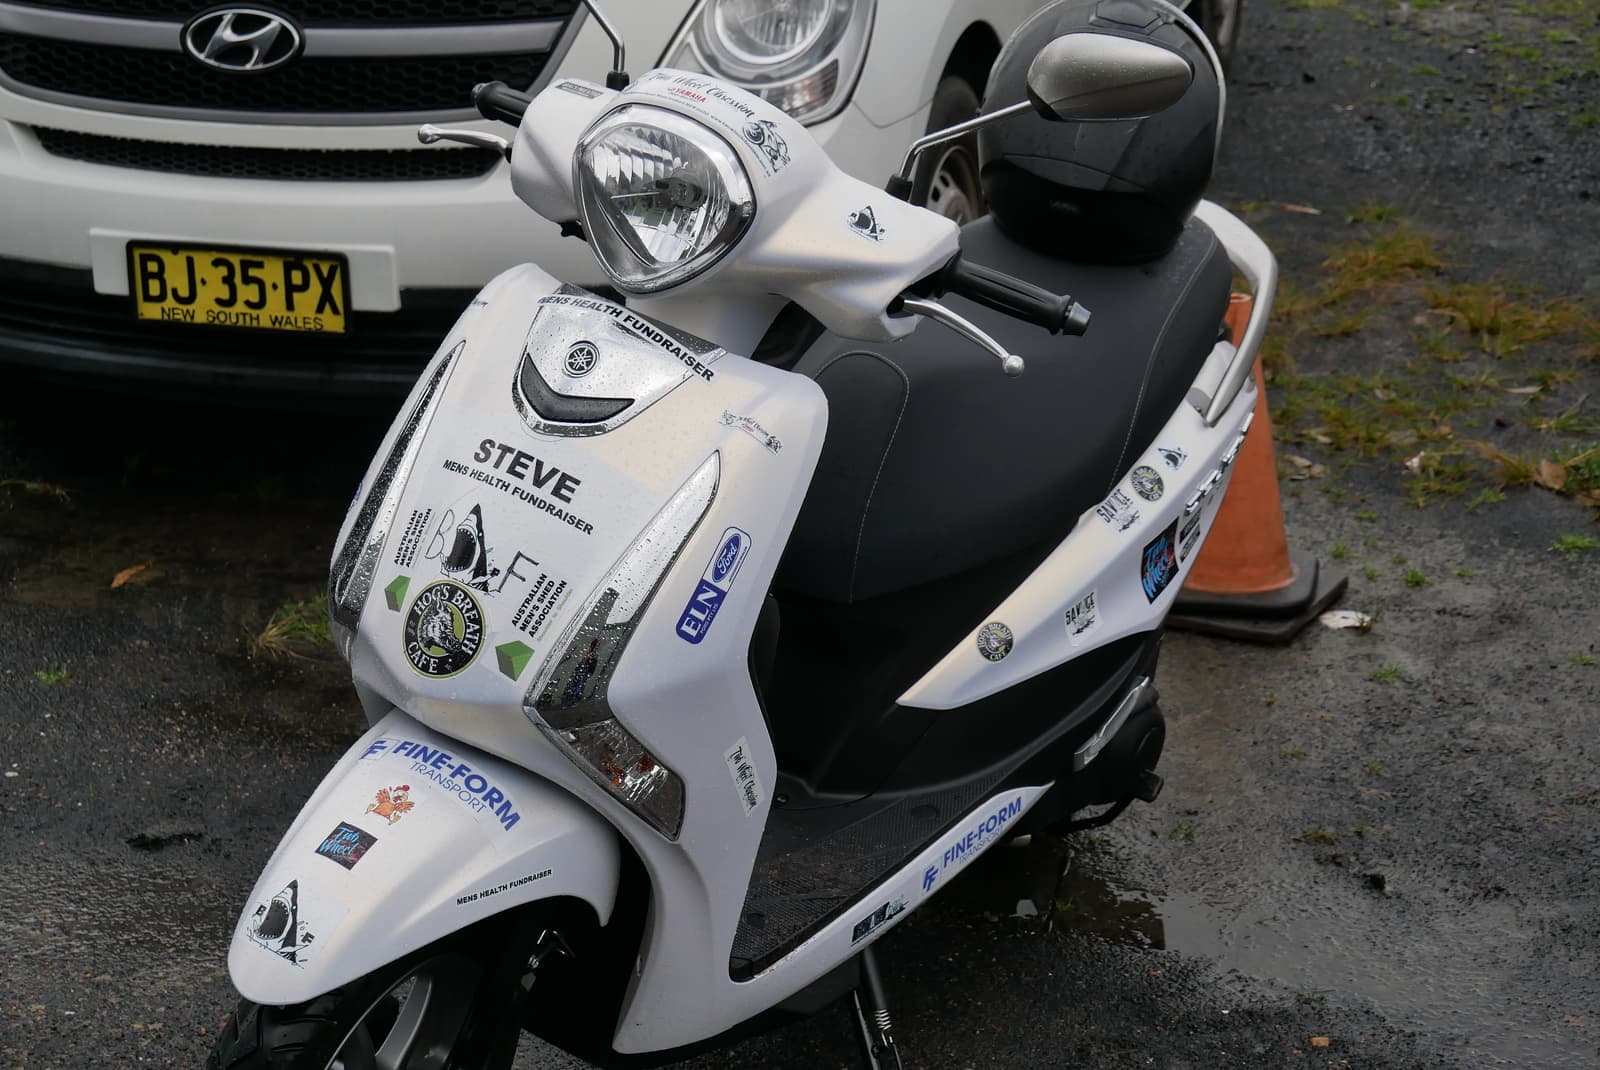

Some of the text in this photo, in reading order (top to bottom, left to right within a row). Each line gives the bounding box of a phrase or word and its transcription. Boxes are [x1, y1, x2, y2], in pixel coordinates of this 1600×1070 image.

[675, 87, 707, 103] YAMAHA
[160, 306, 324, 331] NEW SOUTH WALES
[537, 295, 715, 382] MENS HEALTH FUNDRAISER
[442, 459, 595, 536] MENS HEALTH FUNDRAISER
[473, 437, 582, 504] STEVE
[394, 509, 419, 565] AUSTRALIAN
[405, 508, 433, 568] ASSOCIATION
[410, 512, 424, 537] SHED
[717, 541, 738, 575] Ford
[413, 584, 481, 656] HOG'S BREATH
[511, 573, 548, 627] AUSTRALIAN
[519, 580, 555, 632] MEN'S SHED
[528, 579, 568, 638] ASSOCIATION
[680, 585, 719, 638] ELN
[408, 641, 439, 673] CAFE
[392, 741, 522, 832] FINE-FORM
[409, 760, 488, 814] TRANSPORT
[943, 796, 1022, 869] FINE-FORM
[456, 869, 553, 905] MENS HEALTH FUNDRAISER
